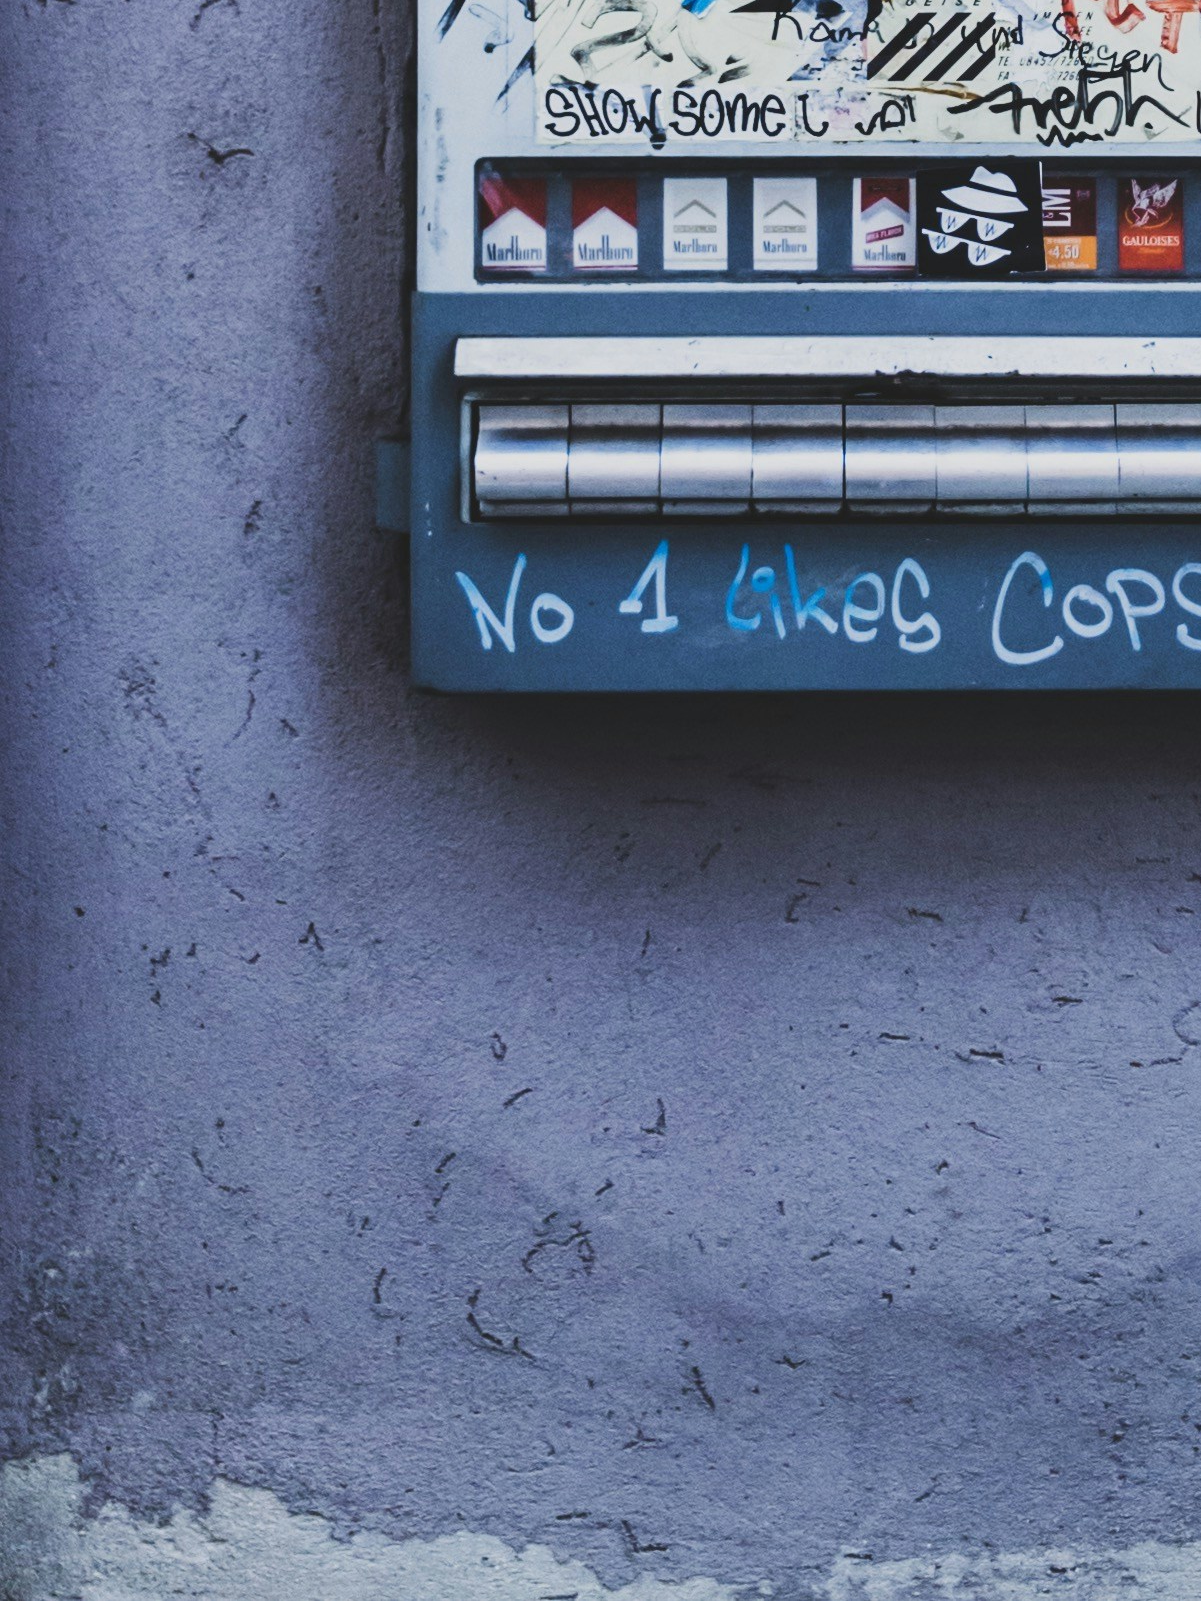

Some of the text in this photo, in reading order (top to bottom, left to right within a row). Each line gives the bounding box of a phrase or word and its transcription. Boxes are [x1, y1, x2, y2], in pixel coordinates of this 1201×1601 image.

[486, 235, 543, 261] Marlboro
[577, 235, 634, 261] Marlboro
[673, 238, 718, 254] Marlboro
[762, 238, 808, 254] Marlboro
[1122, 235, 1181, 247] GAULOISES
[863, 244, 907, 262] Marlboro
[455, 552, 575, 653] No
[618, 538, 679, 634] 1
